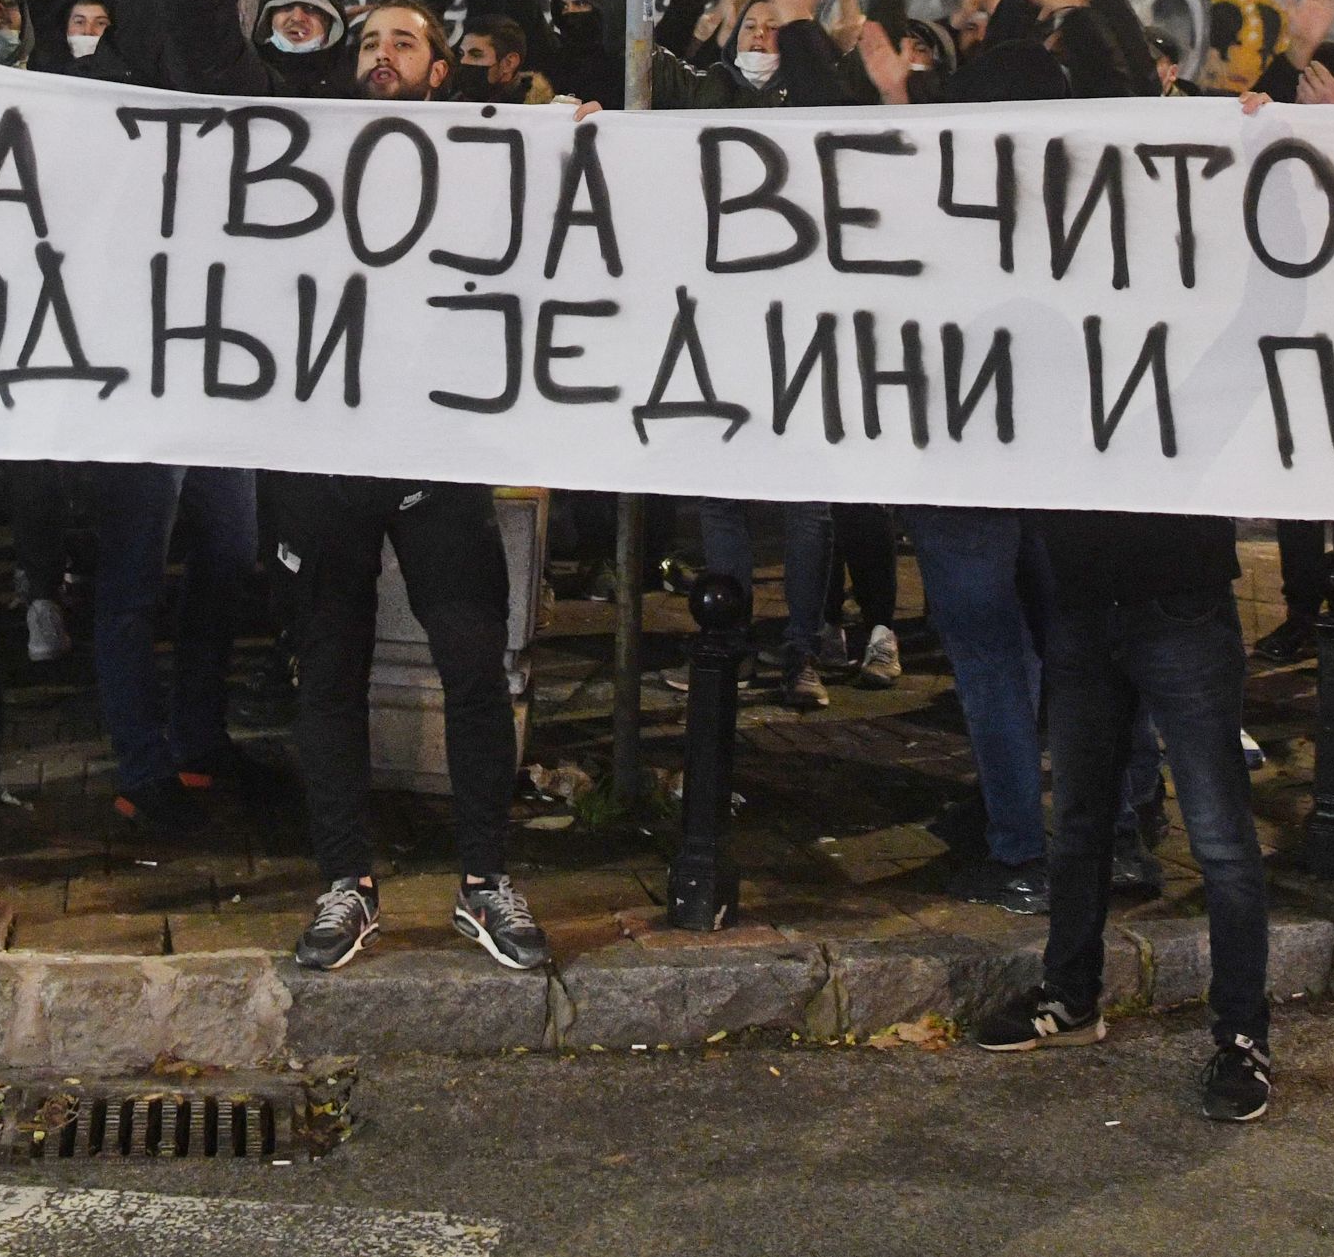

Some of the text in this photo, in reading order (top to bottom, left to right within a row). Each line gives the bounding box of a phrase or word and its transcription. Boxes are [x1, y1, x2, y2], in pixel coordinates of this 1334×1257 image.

[116, 105, 623, 278] ТВОЈА
[426, 280, 1014, 448] ЈЕДИНИ
[1083, 315, 1178, 458] И
